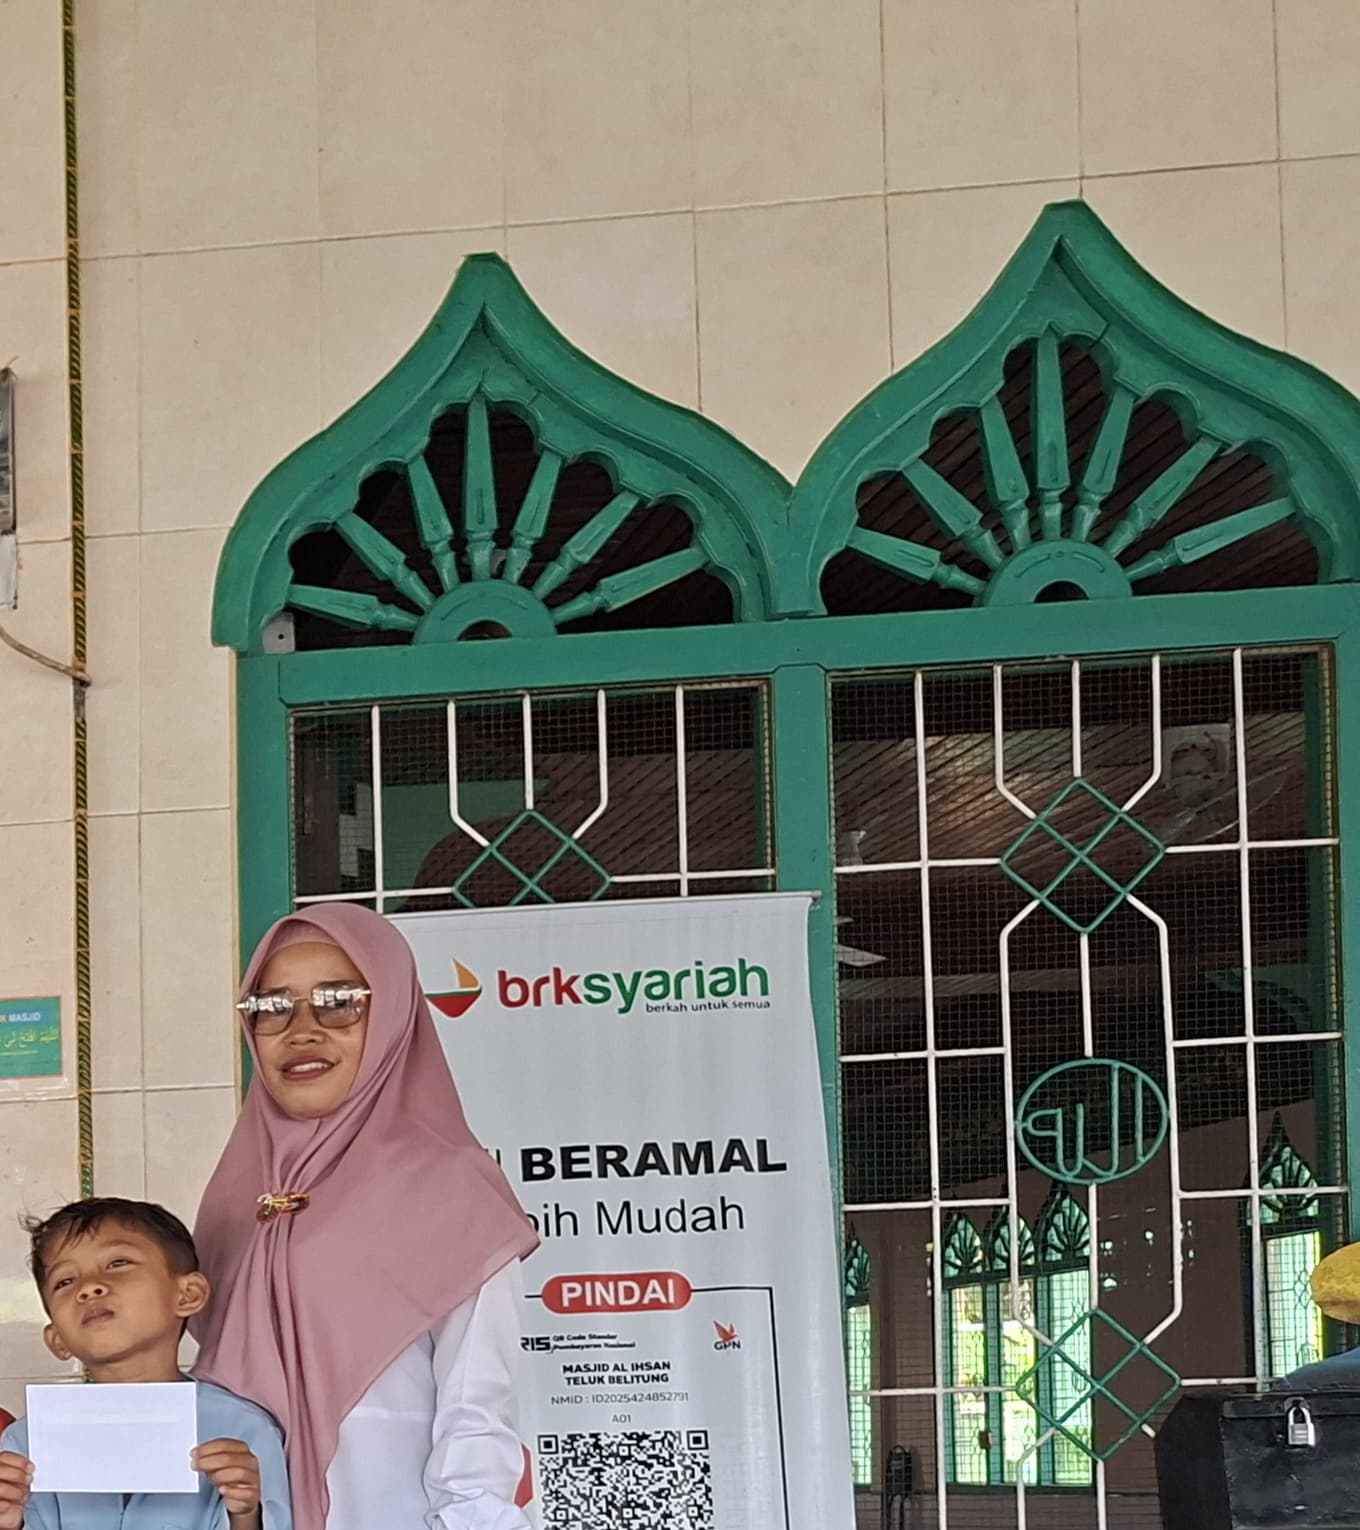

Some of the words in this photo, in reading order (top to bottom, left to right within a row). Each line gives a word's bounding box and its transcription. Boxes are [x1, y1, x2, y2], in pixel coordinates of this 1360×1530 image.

[498, 958, 770, 1014] brksyariah
[646, 1003, 687, 1014] berkah
[691, 1001, 728, 1011] untuk
[732, 1001, 770, 1010] semua
[521, 1139, 787, 1181] BERAMAL
[596, 1196, 745, 1236] Mudah
[561, 1279, 675, 1307] PINDAI
[520, 1336, 550, 1351] RIS
[563, 1363, 609, 1374] MASJID
[612, 1363, 628, 1373] AL
[631, 1361, 671, 1372] IHSAN
[565, 1375, 605, 1386] TELUK
[608, 1373, 669, 1385] BELITUNG
[551, 1395, 583, 1405] NMID
